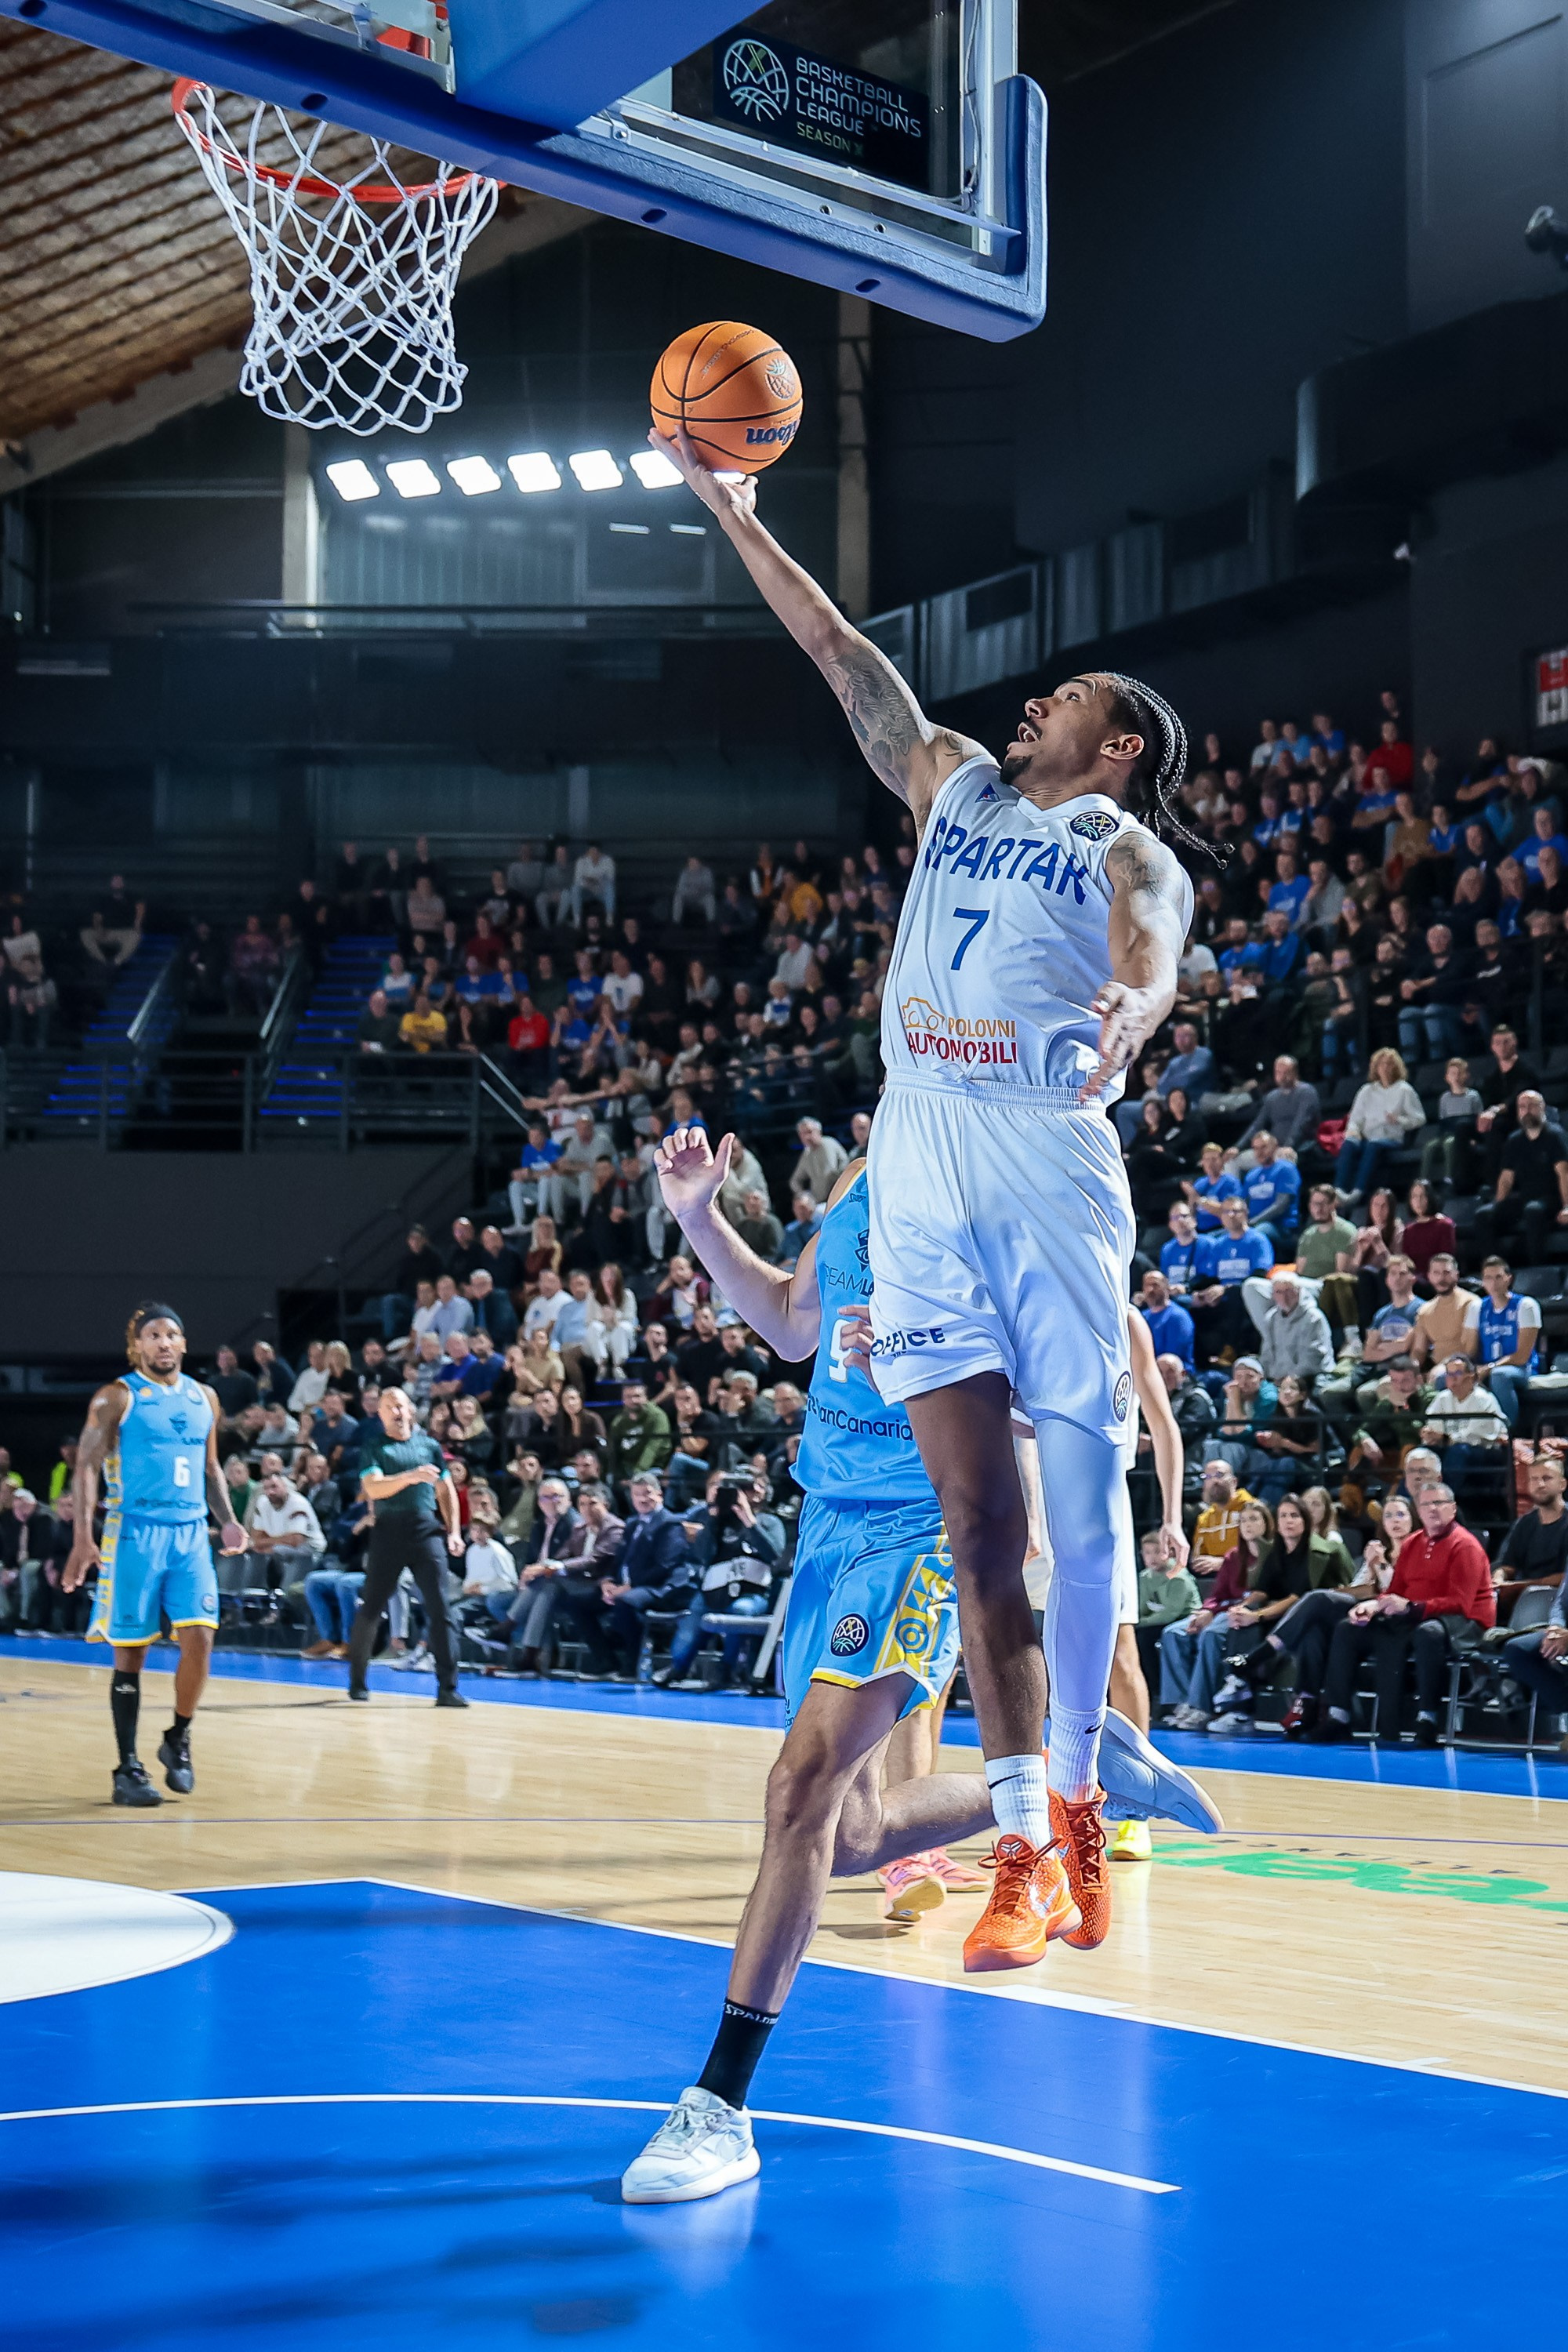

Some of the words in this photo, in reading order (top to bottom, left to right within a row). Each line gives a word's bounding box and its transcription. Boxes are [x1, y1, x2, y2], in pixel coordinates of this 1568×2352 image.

[797, 56, 908, 112] BASKETBALL
[796, 76, 921, 137] CHAMPIONS
[796, 96, 864, 136] LEAGUE
[797, 121, 851, 152] SEASON
[924, 816, 1089, 905] SPARTAK
[950, 907, 989, 971] 7
[947, 1017, 1016, 1038] POLOVNI
[908, 1030, 1018, 1064] AUTOMOBILI
[870, 1327, 946, 1356] OFFICE
[174, 1456, 191, 1487] 6
